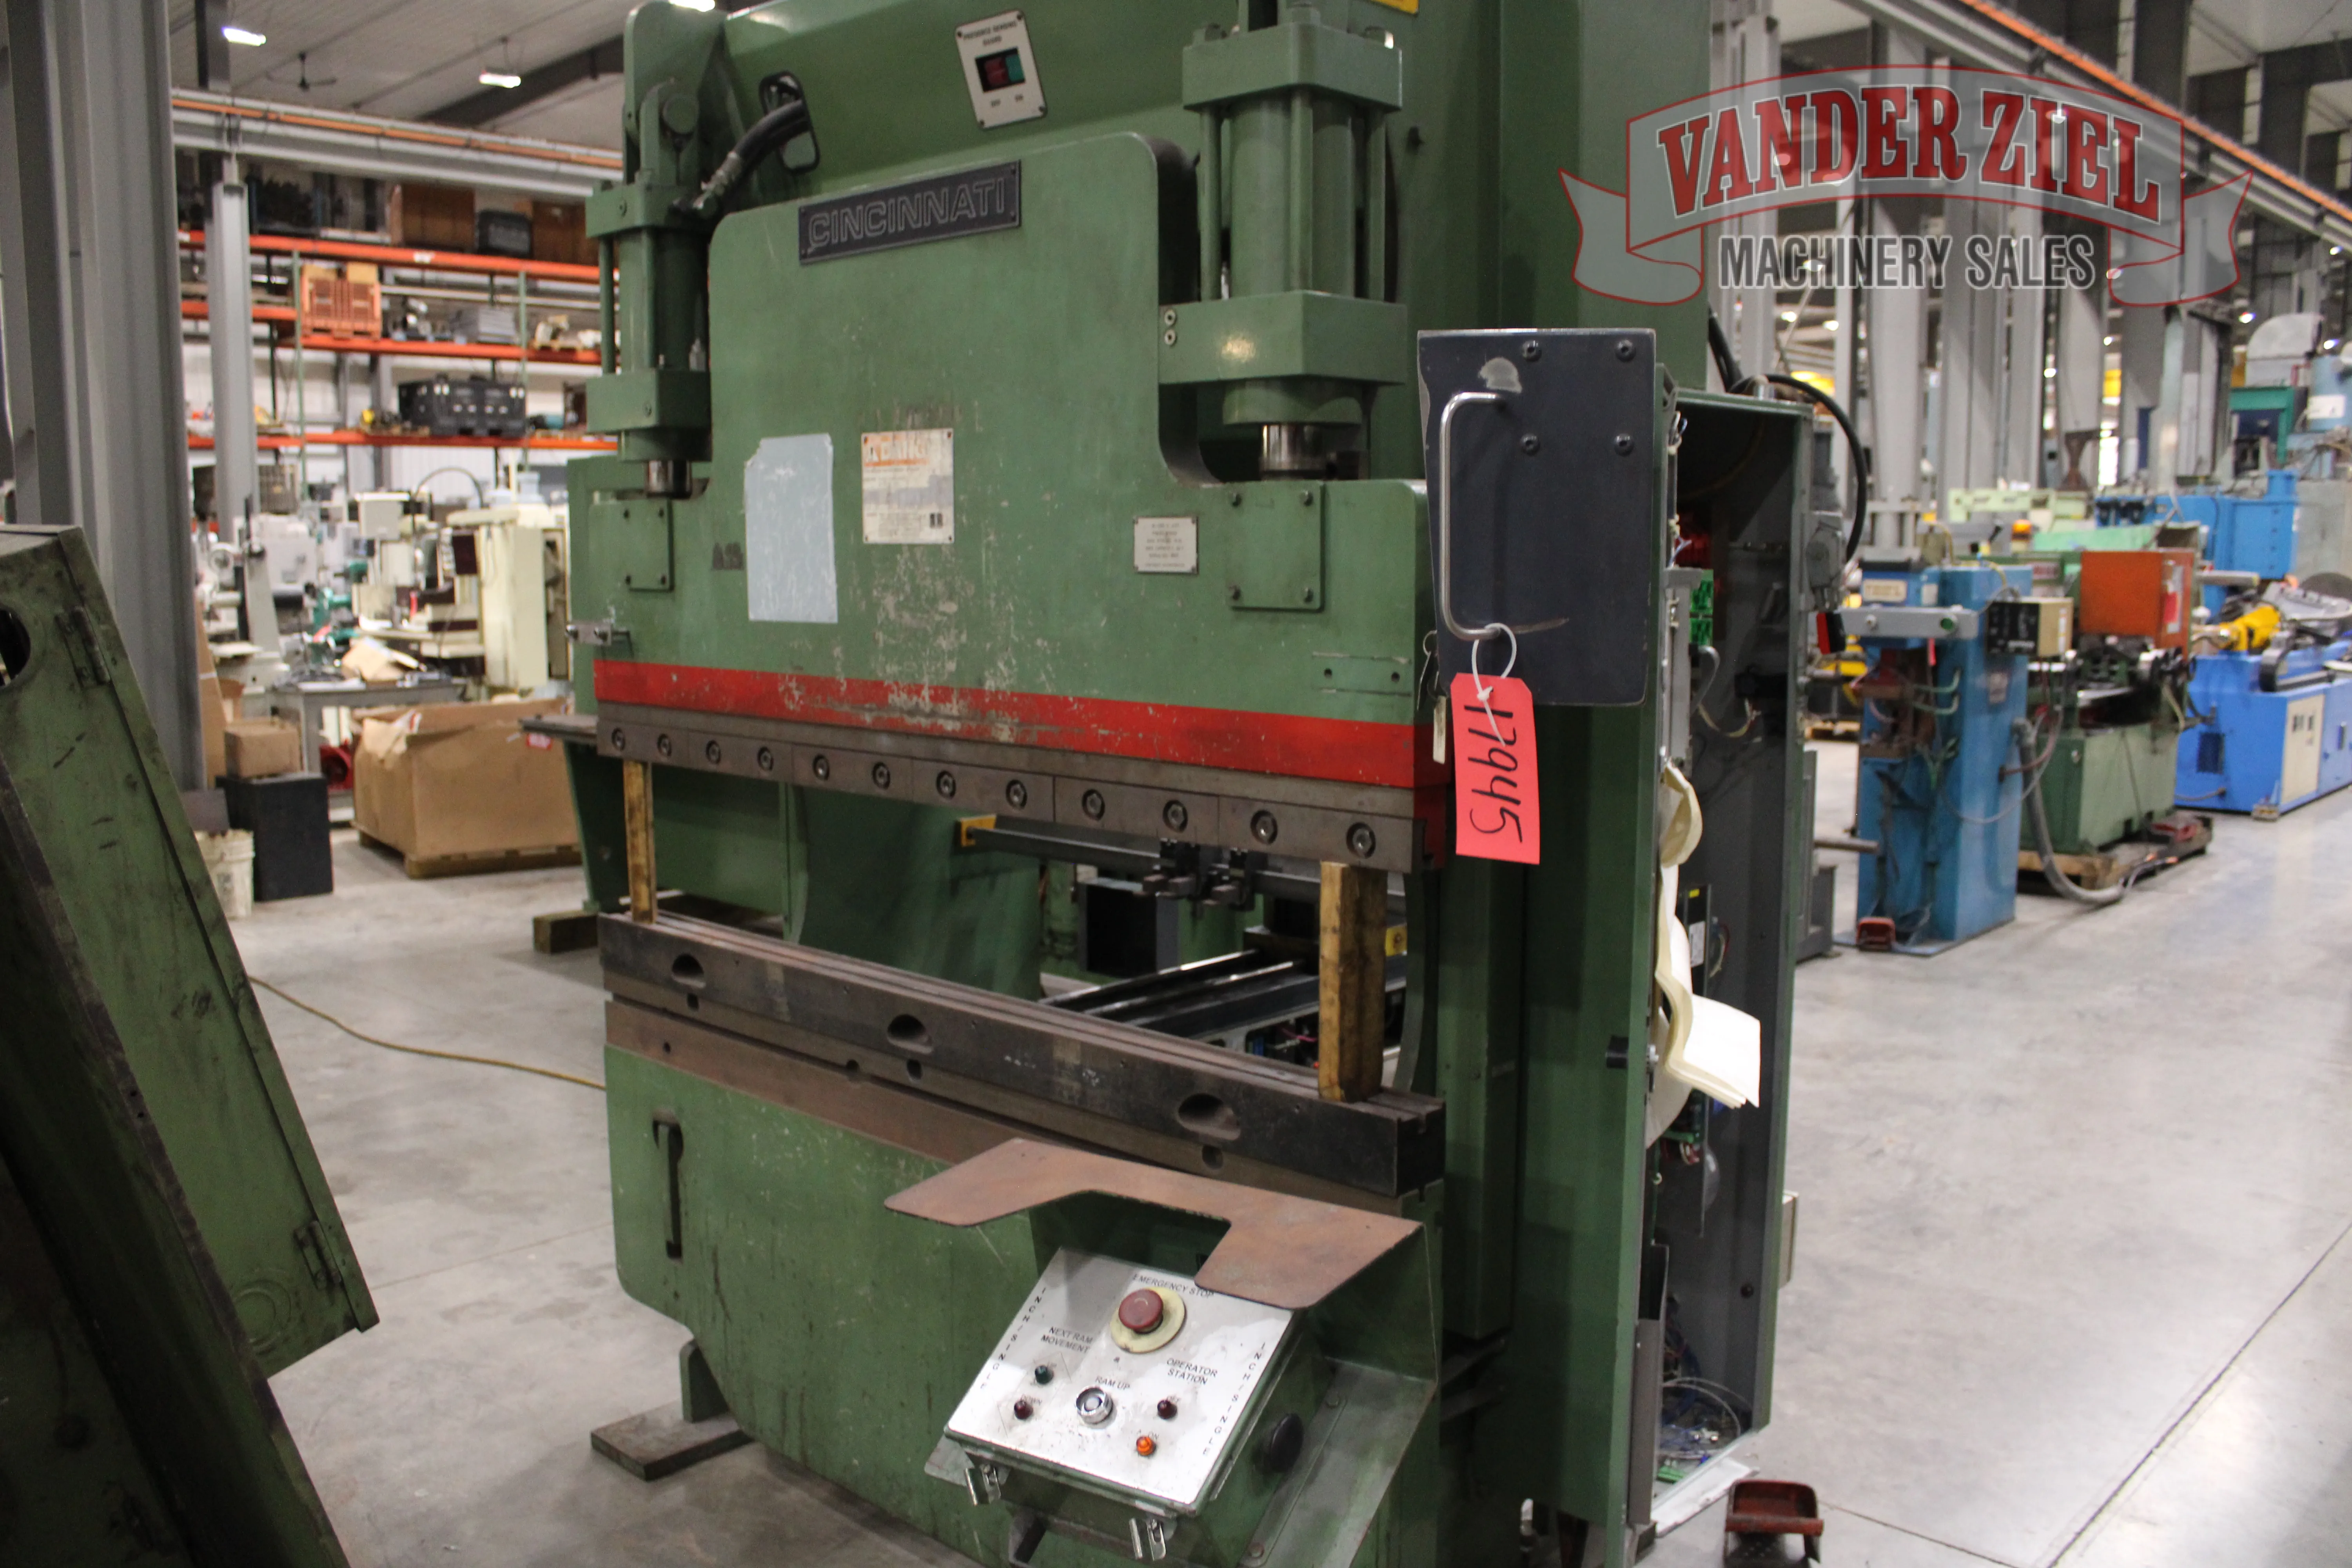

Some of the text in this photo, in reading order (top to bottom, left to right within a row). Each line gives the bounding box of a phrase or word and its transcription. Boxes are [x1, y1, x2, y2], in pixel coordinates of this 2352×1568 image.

[807, 178, 1006, 252] CINCINNATI
[1464, 705, 1523, 843] 17945
[1133, 1274, 1187, 1293] EMERGENCY
[1041, 1334, 1091, 1352] MOVEMENT
[1049, 1327, 1093, 1344] NEXT RAM
[1167, 1358, 1218, 1377] OPERATOR
[1167, 1368, 1208, 1385] STATION
[1095, 1376, 1115, 1387] RAM
